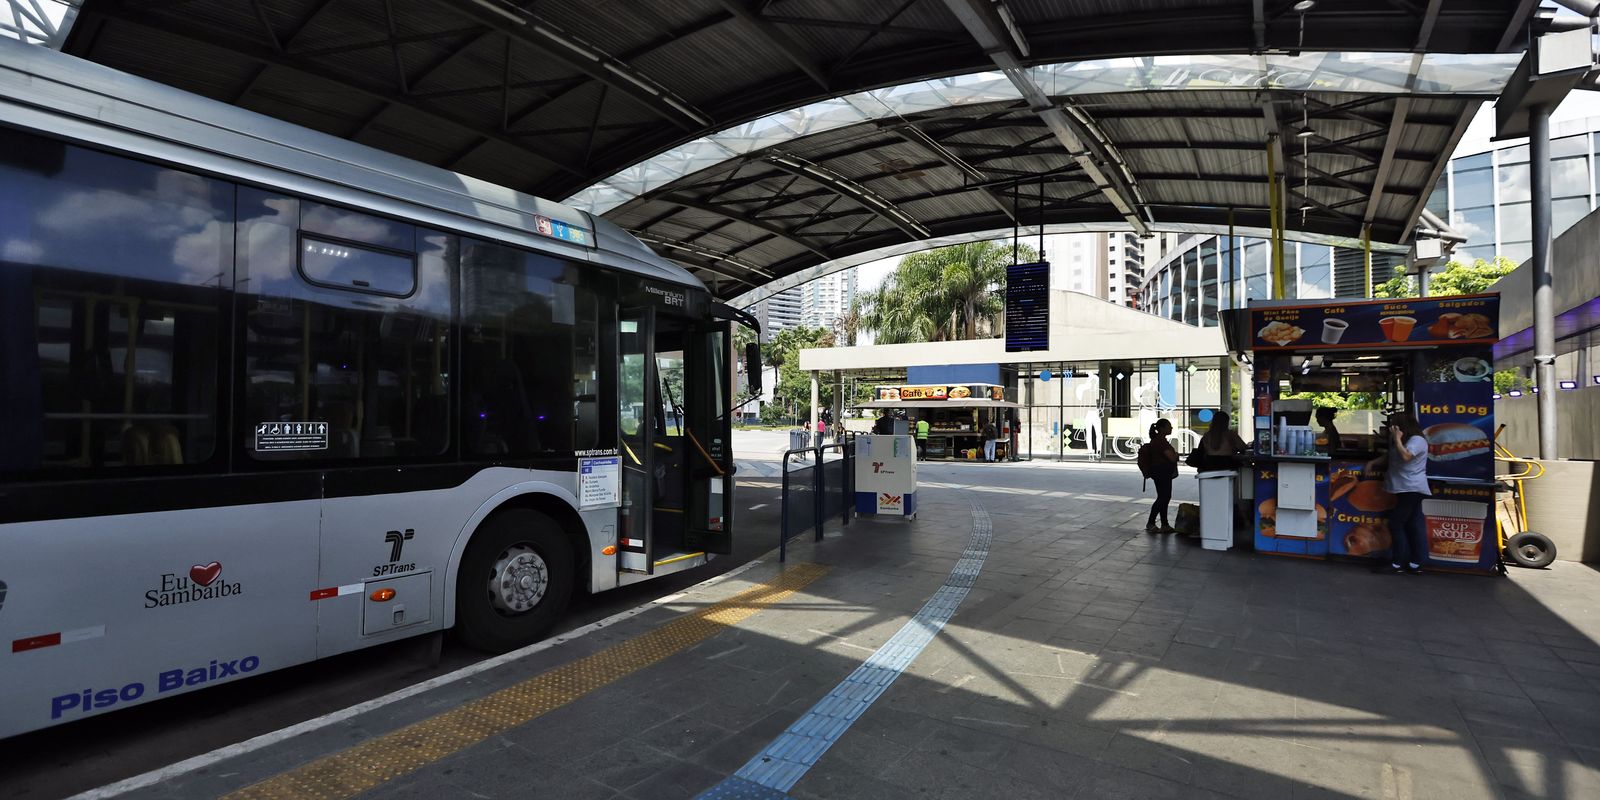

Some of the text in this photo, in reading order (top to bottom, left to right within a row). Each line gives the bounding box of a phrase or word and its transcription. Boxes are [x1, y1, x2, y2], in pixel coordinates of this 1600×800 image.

[664, 295, 684, 307] BRT
[1420, 404, 1488, 416] Hot Dog
[1441, 522, 1468, 532] CUP
[1432, 528, 1476, 540] NOODLES
[373, 563, 416, 577] SPTrans
[161, 573, 188, 593] Eu
[144, 579, 242, 609] Sambaíba
[51, 655, 260, 720] Piso Baixo
